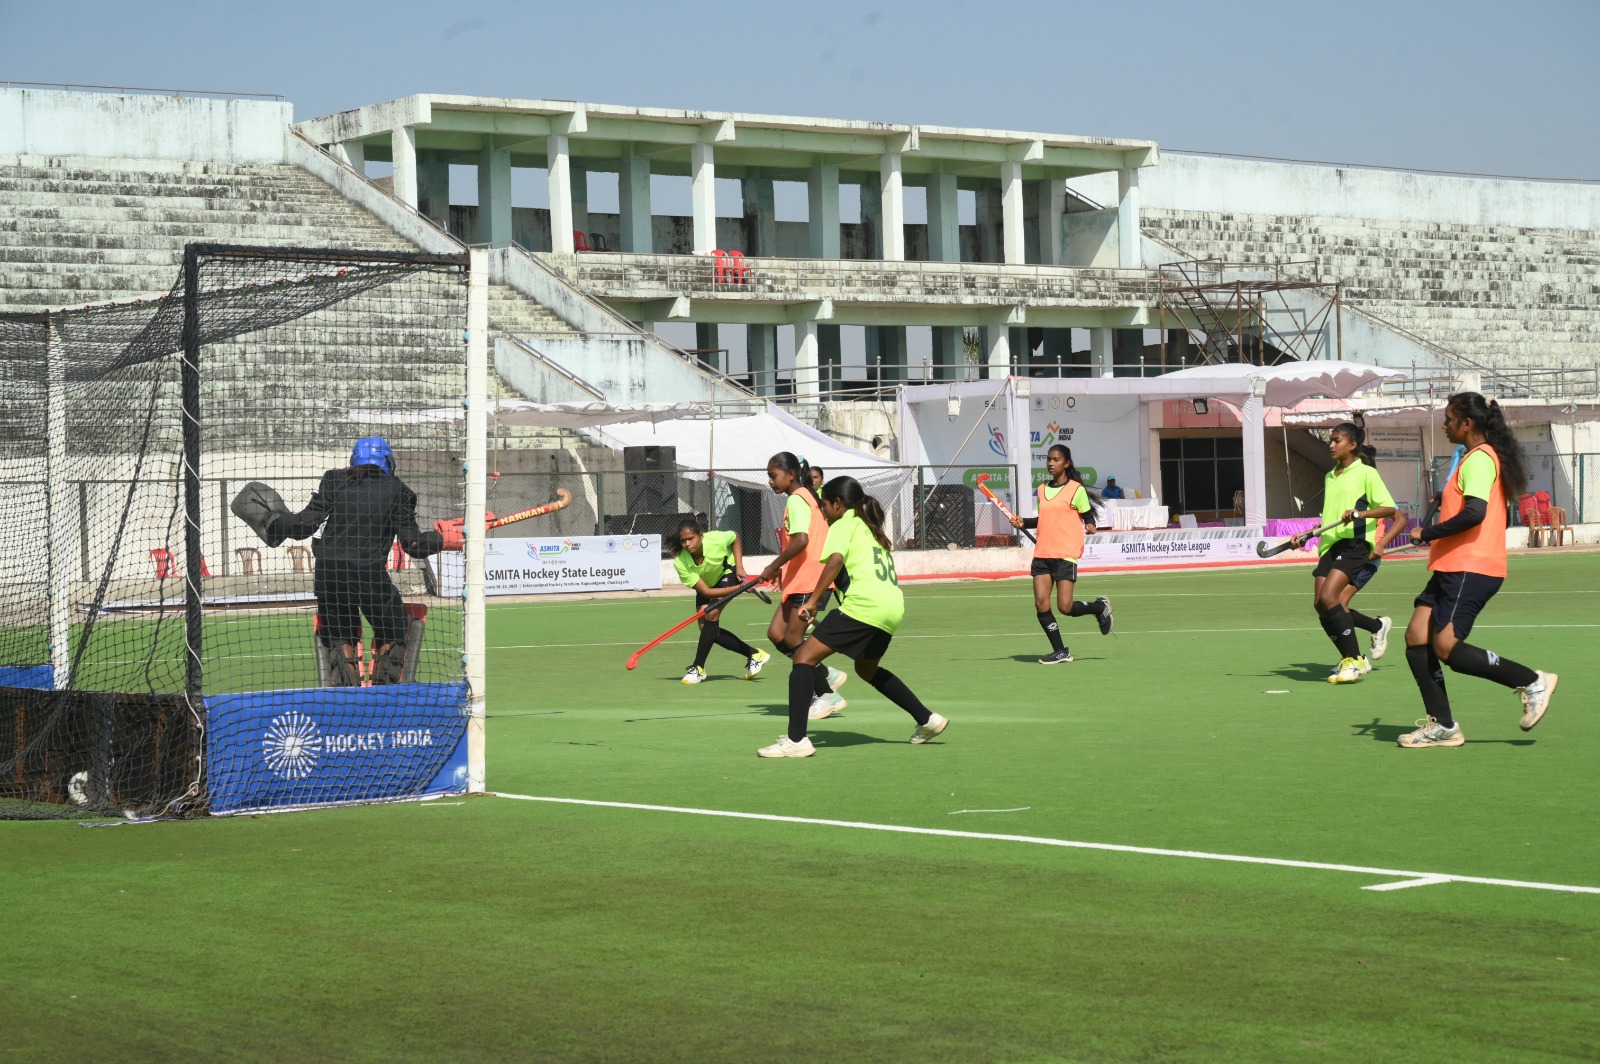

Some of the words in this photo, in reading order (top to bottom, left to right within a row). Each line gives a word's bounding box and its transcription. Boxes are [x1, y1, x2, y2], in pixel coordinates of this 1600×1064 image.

[500, 506, 546, 526] HARMAN
[1121, 543, 1146, 553] ASMITA
[1146, 542, 1170, 554] Hockey
[1171, 542, 1187, 551] State
[1188, 541, 1210, 553] League
[522, 568, 560, 581] Hockey
[562, 567, 588, 578] State
[590, 566, 626, 580] League
[872, 546, 898, 586] 58
[325, 732, 386, 753] HOCKEY
[391, 728, 433, 748] INDIA
